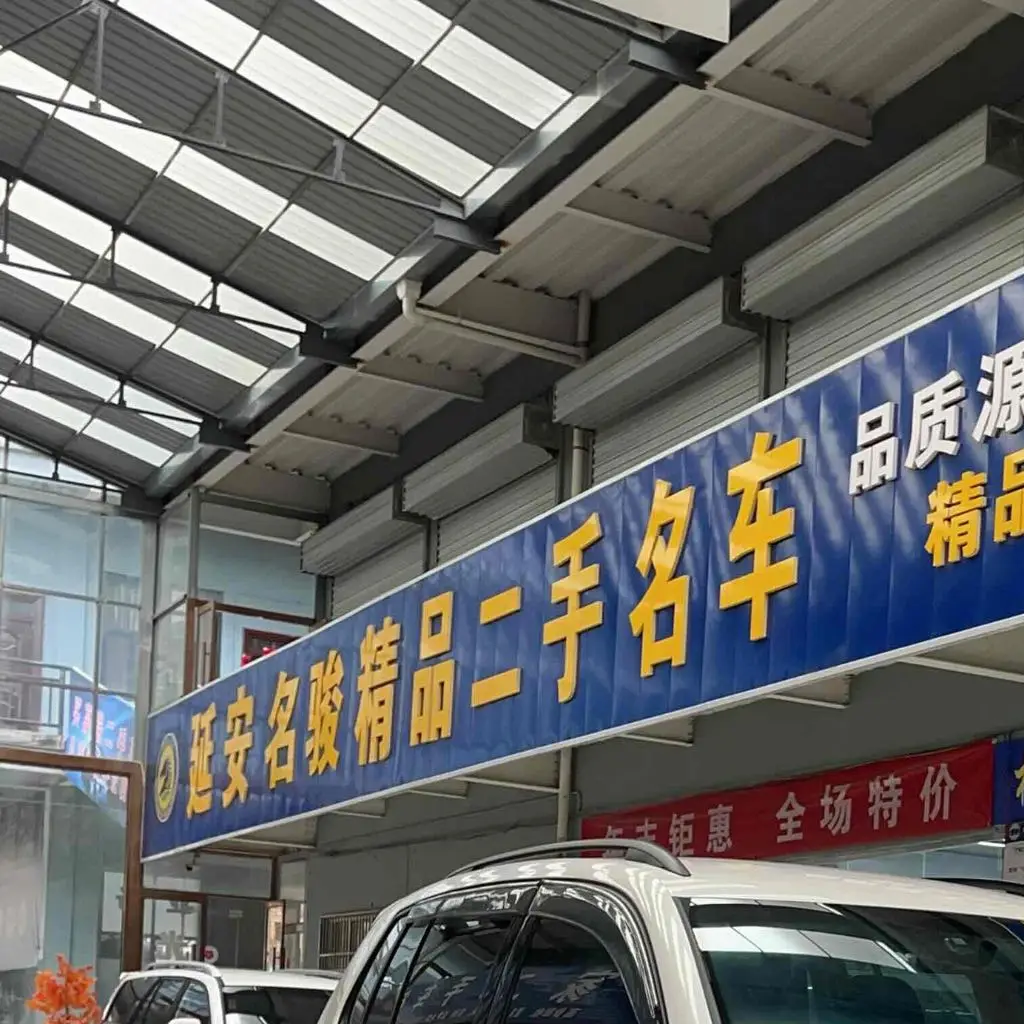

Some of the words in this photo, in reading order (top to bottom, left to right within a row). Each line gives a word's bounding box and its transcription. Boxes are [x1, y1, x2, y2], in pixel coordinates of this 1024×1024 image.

[186, 431, 805, 819] 延安名骏精品二手名车
[775, 763, 959, 844] 全场特价
